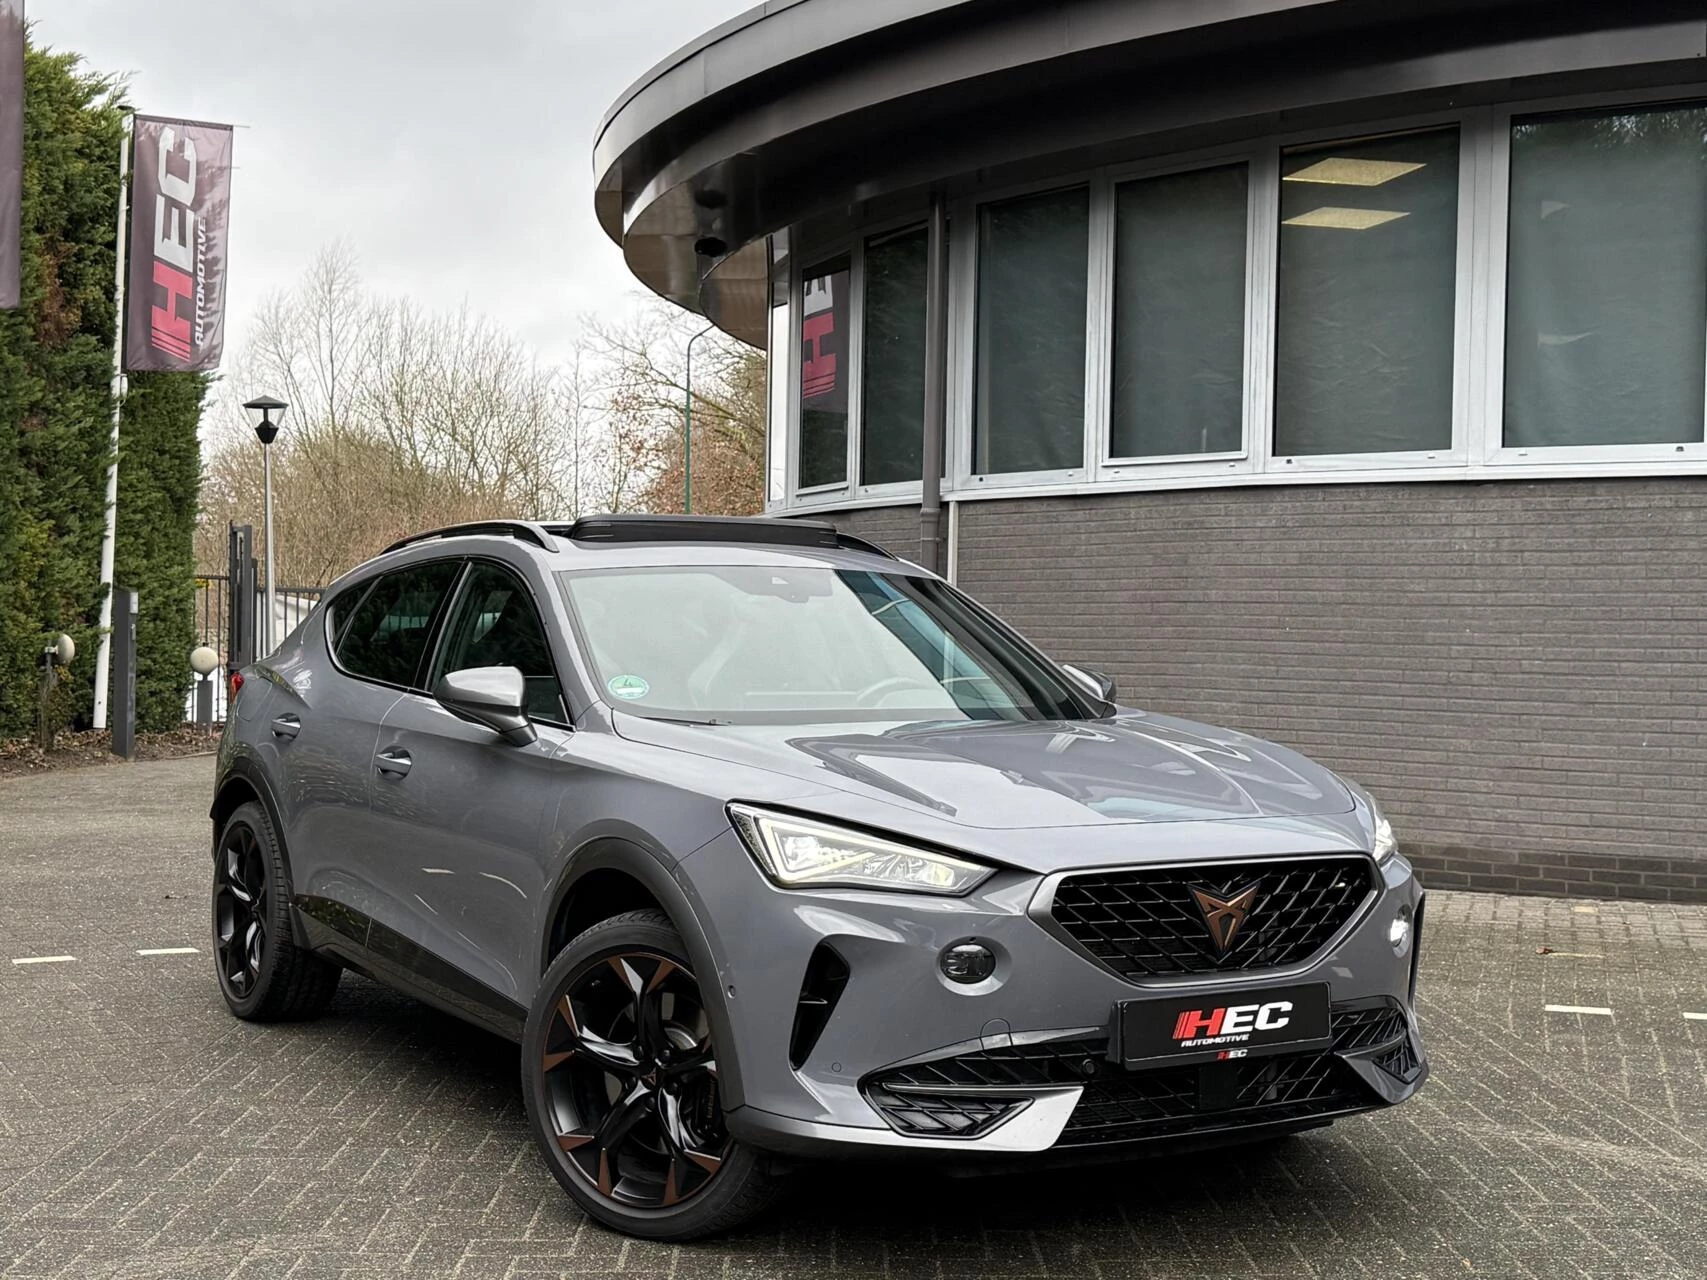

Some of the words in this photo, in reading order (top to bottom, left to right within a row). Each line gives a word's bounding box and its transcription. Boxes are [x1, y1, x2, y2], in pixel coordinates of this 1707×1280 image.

[151, 126, 197, 362] HEC
[195, 216, 207, 347] AUTOMOTIVE
[1172, 1001, 1293, 1040] HEC
[1181, 1034, 1250, 1048] AUTOMOTIVE
[1216, 1049, 1248, 1060] HEC
